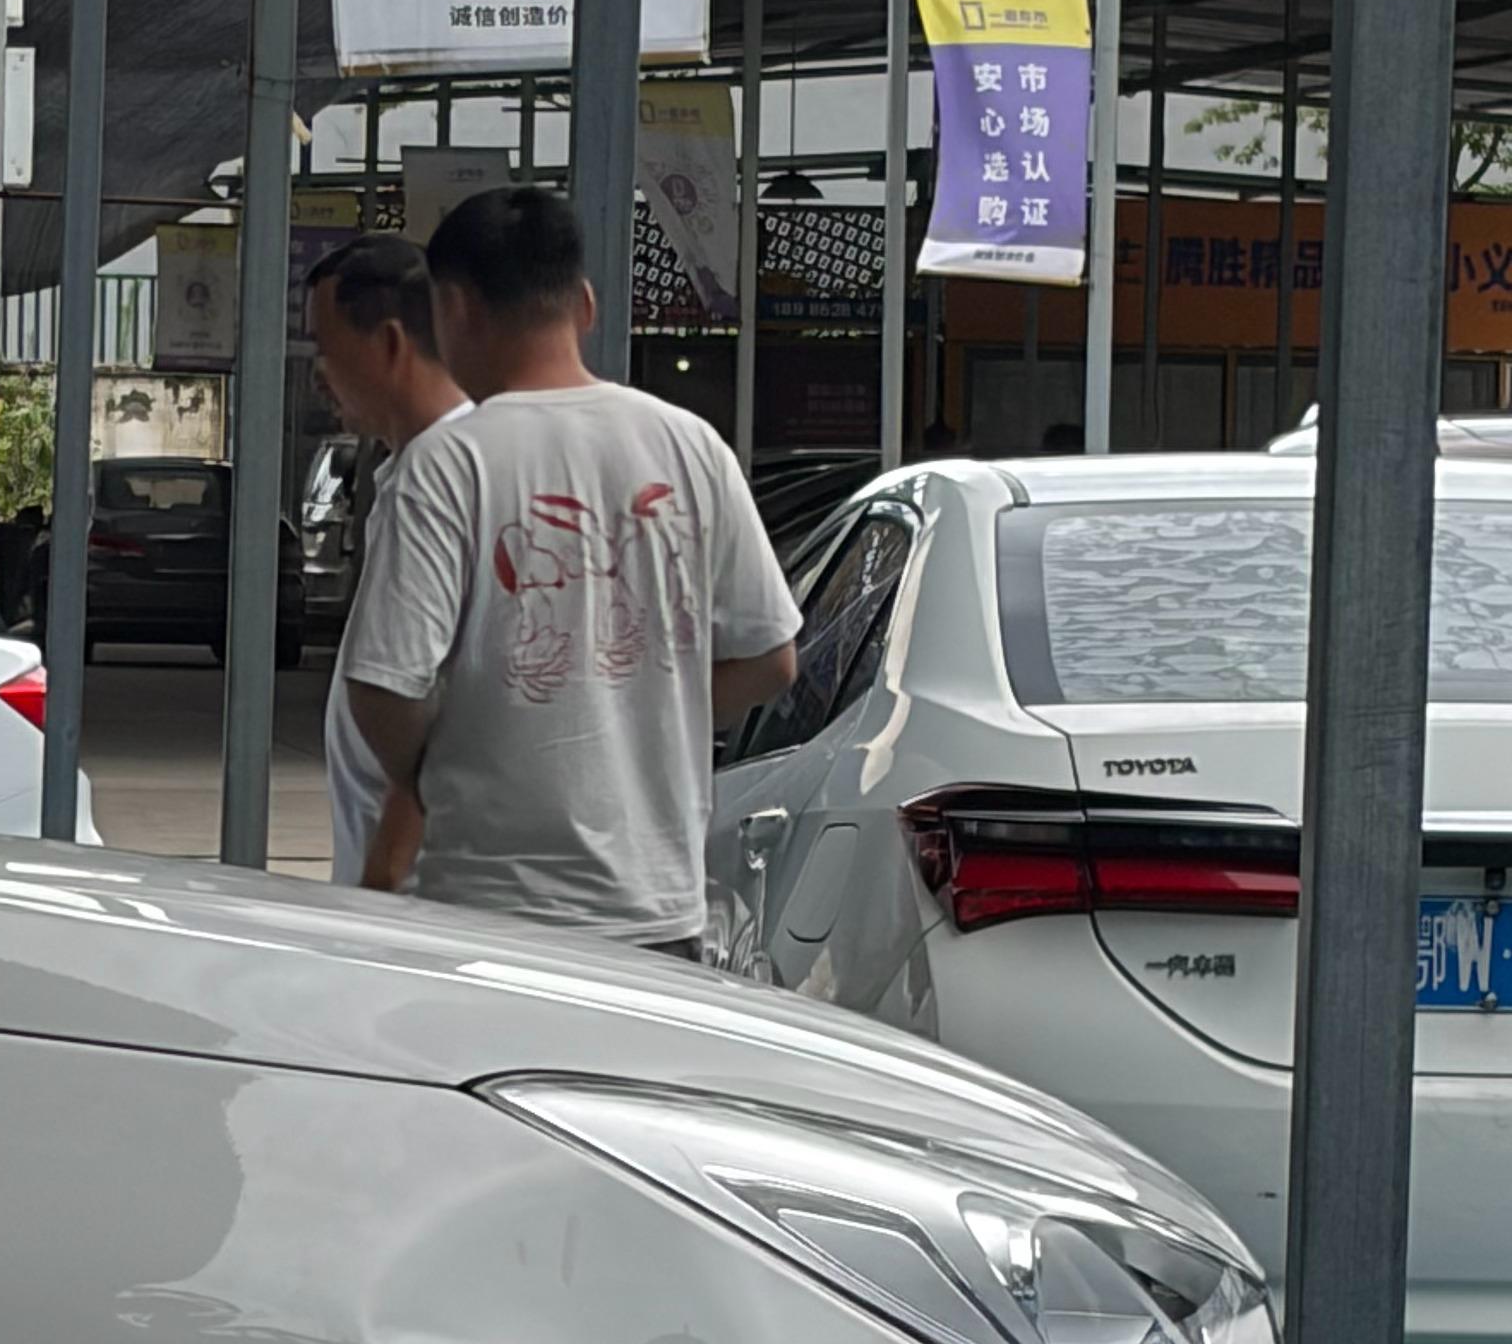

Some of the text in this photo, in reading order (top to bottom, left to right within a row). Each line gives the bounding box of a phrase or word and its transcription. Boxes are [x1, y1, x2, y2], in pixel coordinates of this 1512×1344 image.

[449, 4, 575, 28] 诚信创造价
[973, 63, 1009, 227] 安心选购
[1018, 63, 1051, 227] 市场认证
[1103, 757, 1198, 777] TOYOTA
